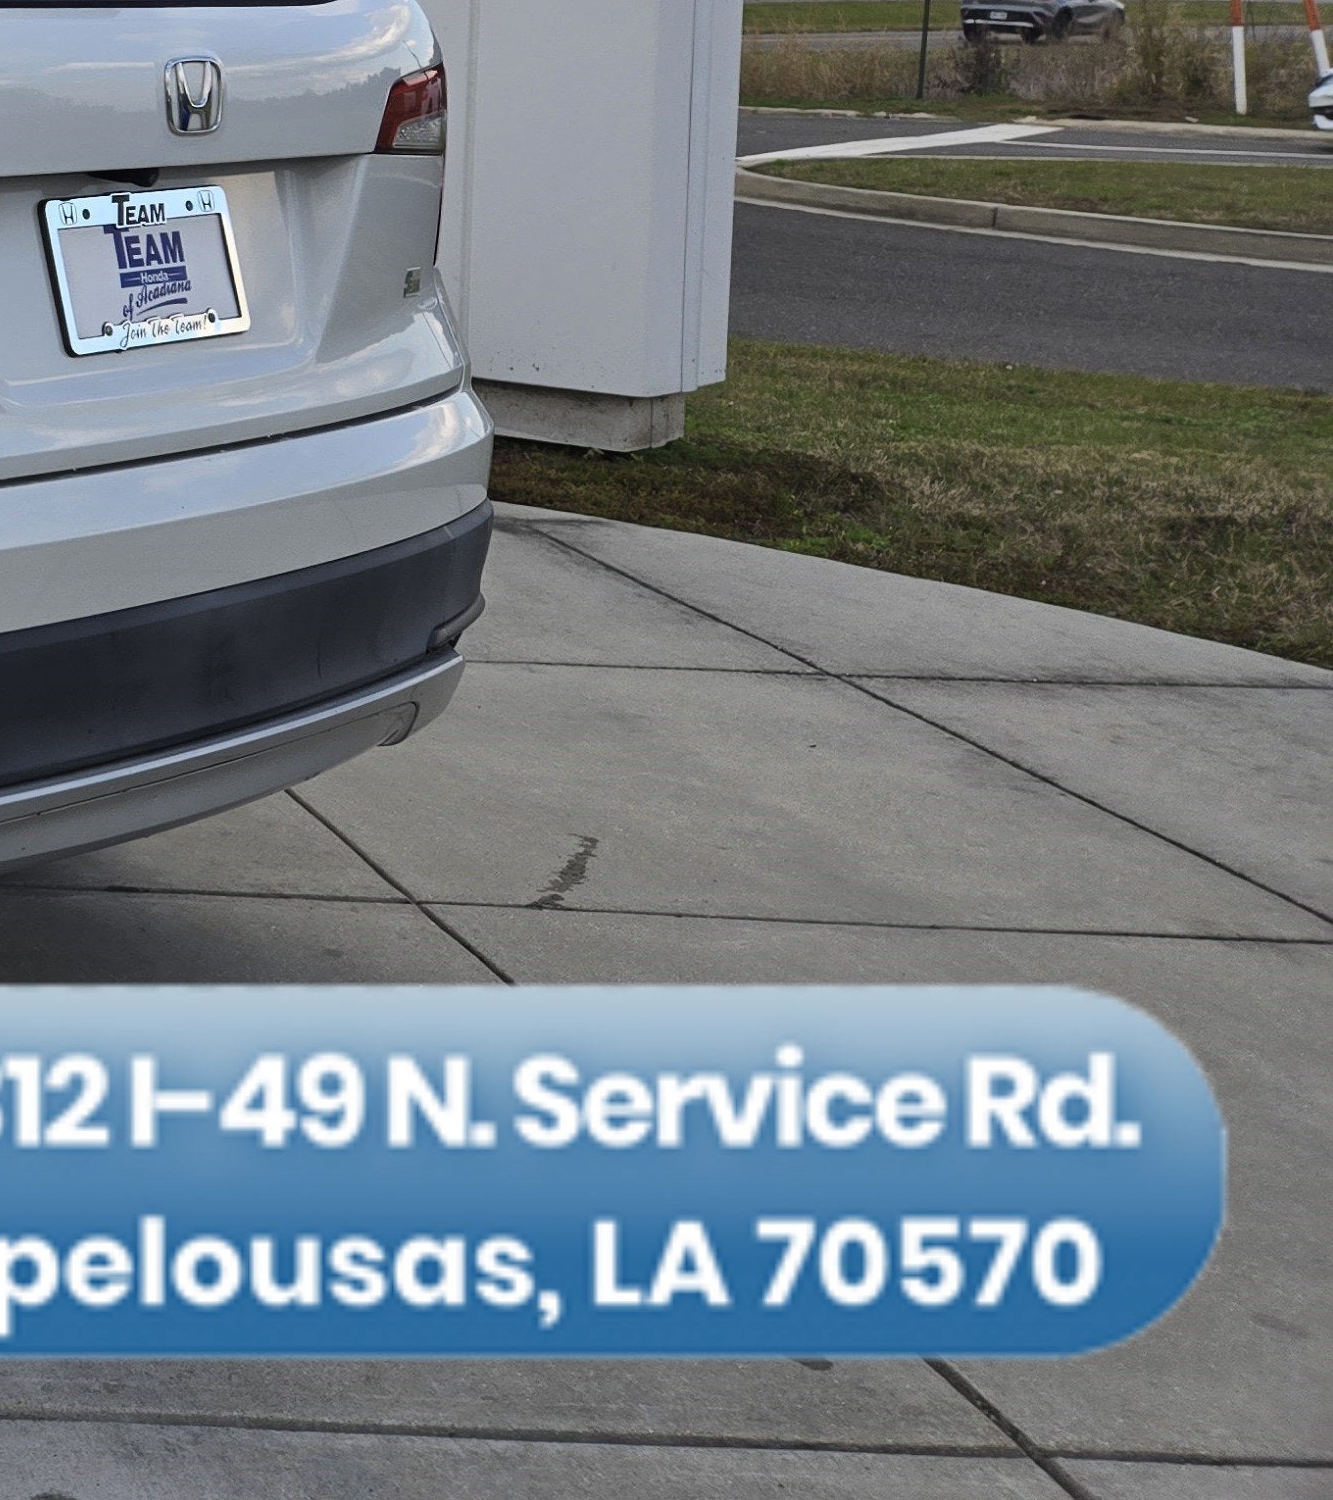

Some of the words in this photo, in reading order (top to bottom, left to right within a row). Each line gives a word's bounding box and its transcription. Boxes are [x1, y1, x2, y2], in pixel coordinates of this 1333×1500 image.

[140, 270, 170, 284] Honda
[136, 280, 192, 308] Acadiana
[120, 322, 147, 348] Join
[148, 316, 170, 338] The
